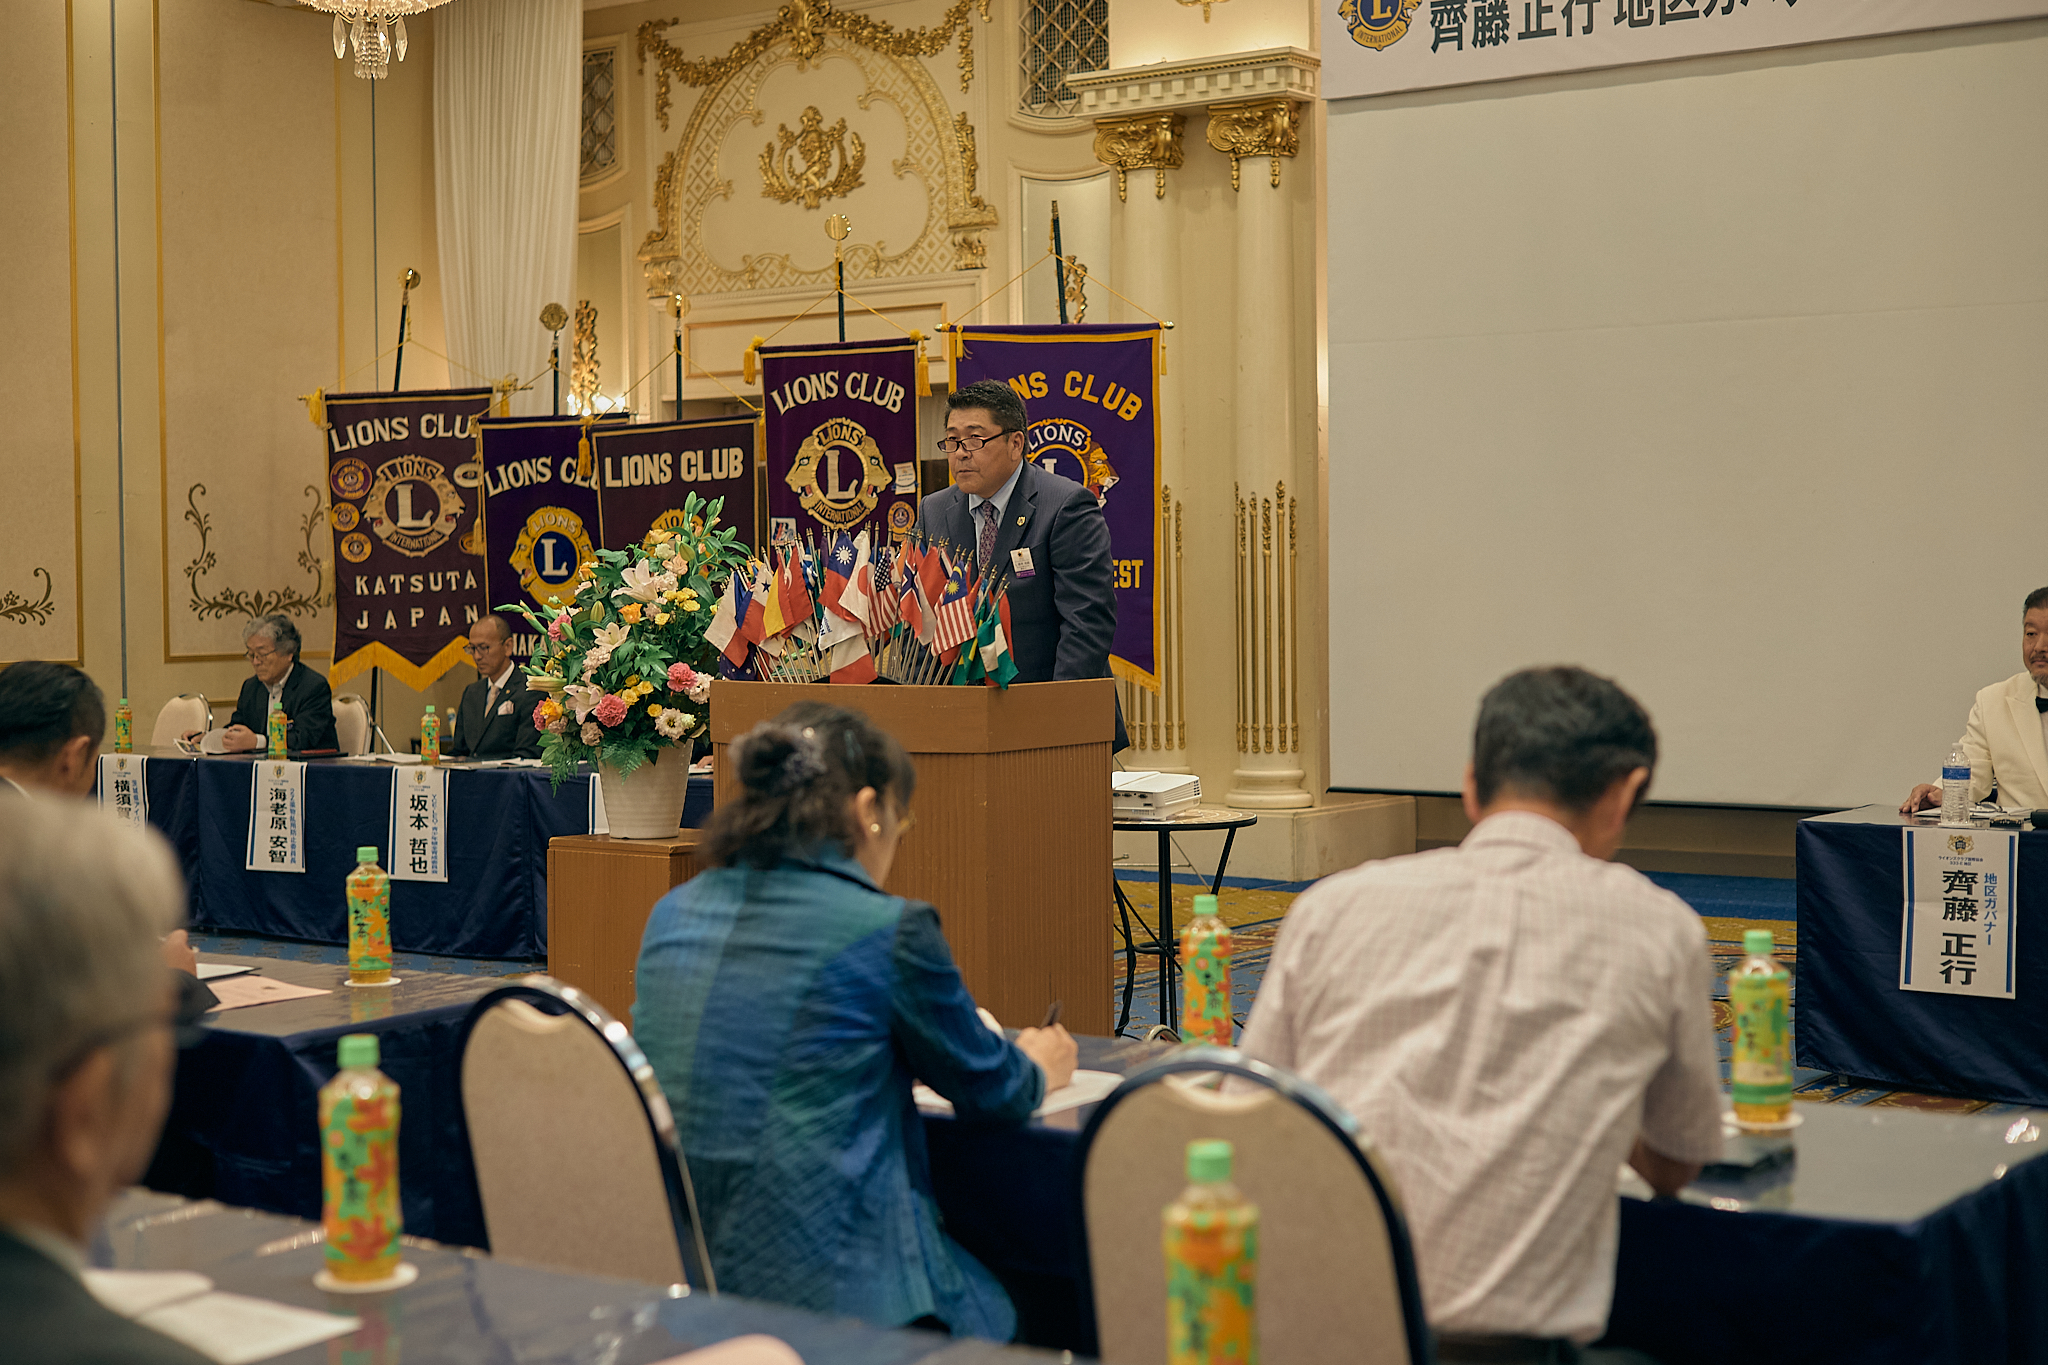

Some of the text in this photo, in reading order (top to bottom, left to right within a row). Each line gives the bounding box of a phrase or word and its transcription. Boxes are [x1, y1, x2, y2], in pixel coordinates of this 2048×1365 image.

[1356, 26, 1404, 44] INTERNATIONAL
[770, 370, 905, 415] LIONS CLUB
[1063, 370, 1143, 421] CLUB
[330, 413, 479, 452] LIONS CLU
[818, 428, 863, 448] LIONS
[1028, 425, 1085, 451] LIONS
[382, 459, 438, 480] LIONS
[485, 456, 552, 498] LIONS
[604, 447, 744, 488] LIONS CLUB
[825, 450, 859, 500] L
[395, 483, 434, 529] L
[531, 513, 578, 534] LIONS
[813, 500, 866, 523] INTERNATIONAL
[389, 531, 444, 550] INTERNATIONAL
[541, 538, 569, 577] L
[355, 569, 478, 596] KATSUTA
[356, 604, 479, 630] JAPAN
[269, 787, 288, 830] 海老原
[409, 794, 429, 831] 坂本
[268, 835, 288, 864] 安智
[409, 837, 429, 874] 哲也
[1939, 870, 1979, 985] 齊藤 正行
[1983, 872, 1998, 946] 地区ガバナー
